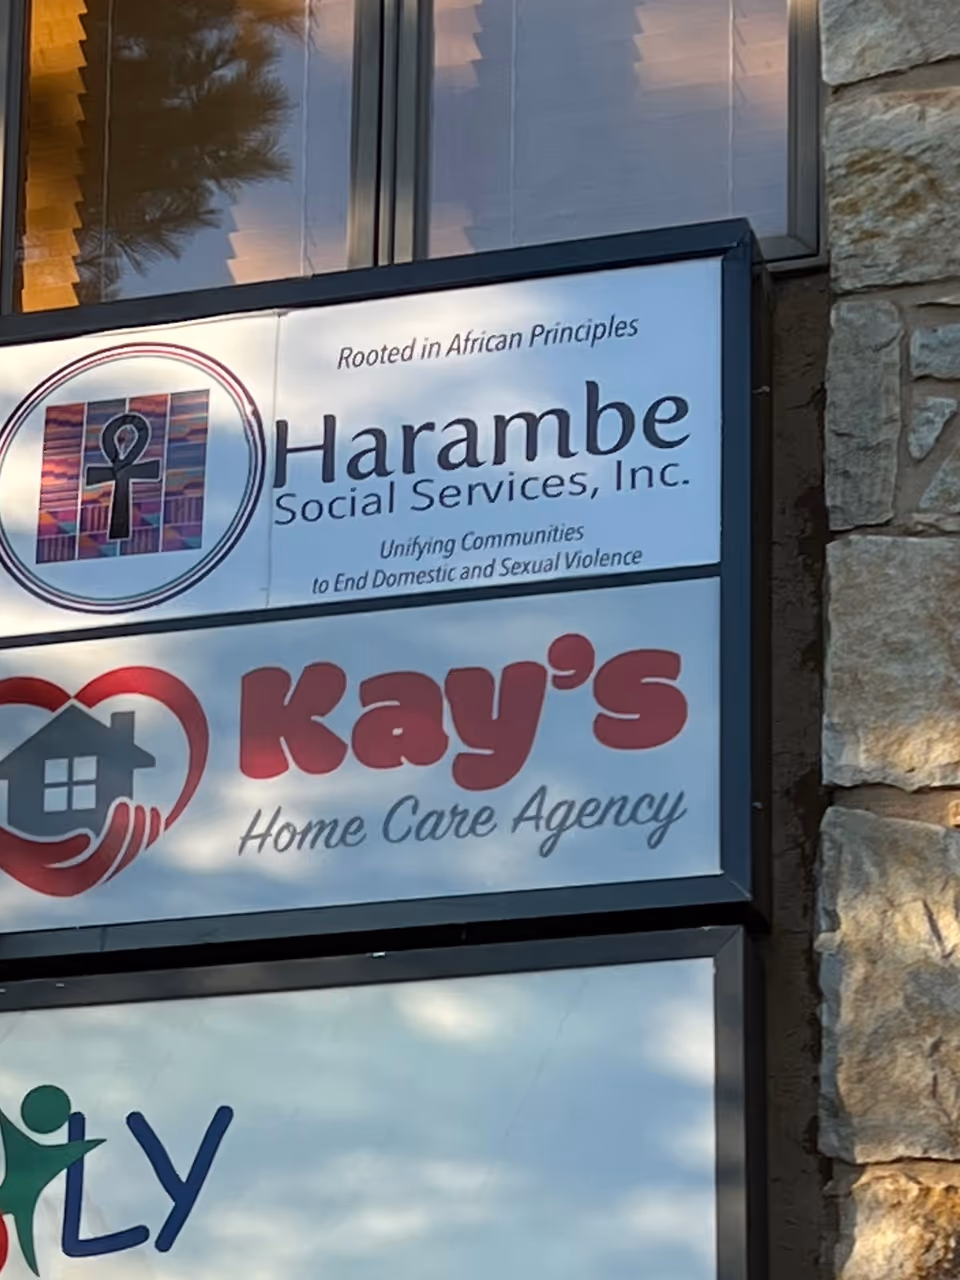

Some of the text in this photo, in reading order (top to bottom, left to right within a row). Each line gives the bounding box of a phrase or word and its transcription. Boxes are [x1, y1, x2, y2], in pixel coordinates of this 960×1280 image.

[336, 314, 640, 370] Rooted in African Principles
[272, 380, 692, 489] Harambe
[273, 459, 691, 526] Social Services, Inc.
[311, 547, 644, 595] to End Domestic and Sexual Violence
[379, 523, 585, 562] Unifying Communities
[239, 632, 690, 792] Kay's
[238, 784, 689, 859] Home Care Agency
